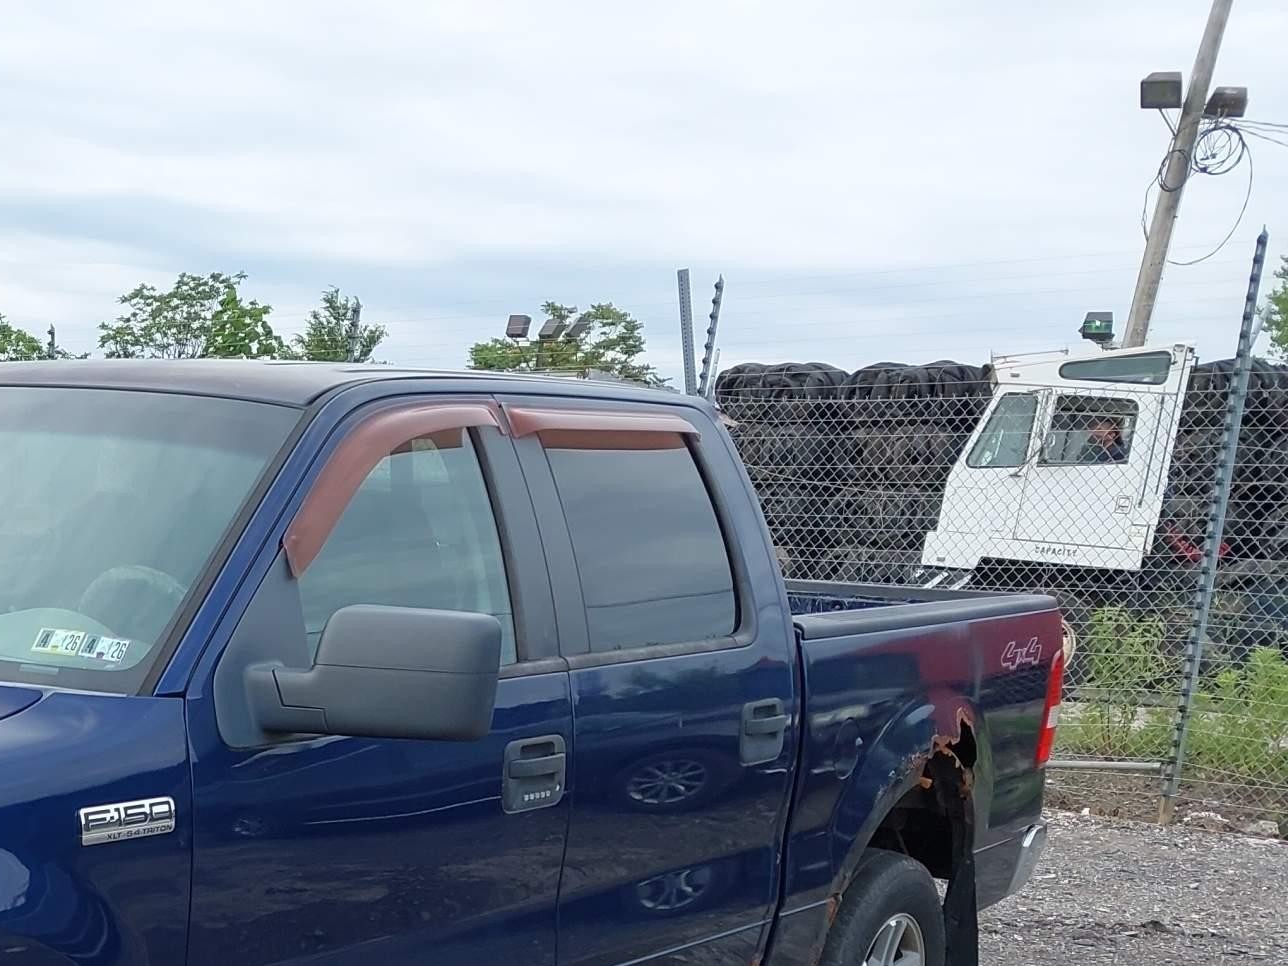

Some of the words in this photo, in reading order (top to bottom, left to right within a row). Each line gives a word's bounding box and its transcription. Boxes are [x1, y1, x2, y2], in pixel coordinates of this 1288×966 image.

[1034, 544, 1078, 557] CAPACITY
[40, 633, 50, 648] 4
[87, 638, 97, 654] 4
[110, 641, 126, 660] 26
[1001, 636, 1042, 670] 4x4
[143, 824, 172, 835] TRITON
